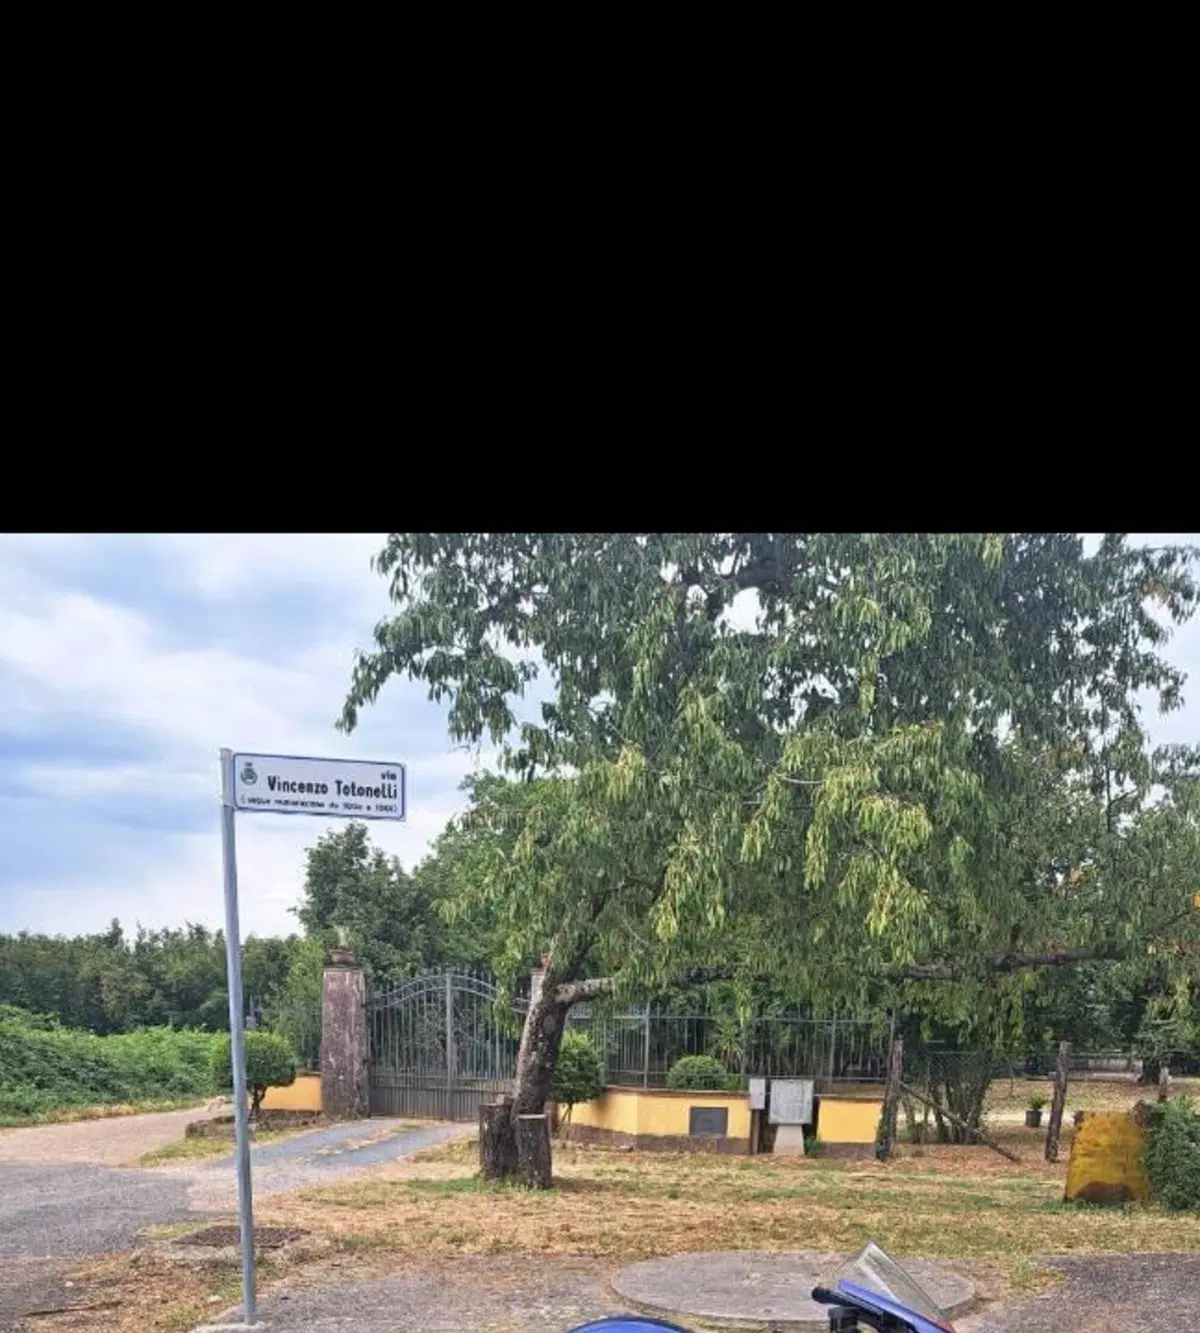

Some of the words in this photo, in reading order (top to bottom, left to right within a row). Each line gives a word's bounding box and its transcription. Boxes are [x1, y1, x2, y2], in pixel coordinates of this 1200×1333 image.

[381, 770, 397, 781] via
[267, 775, 329, 795] Vincenzo
[335, 779, 398, 800] Totonelli
